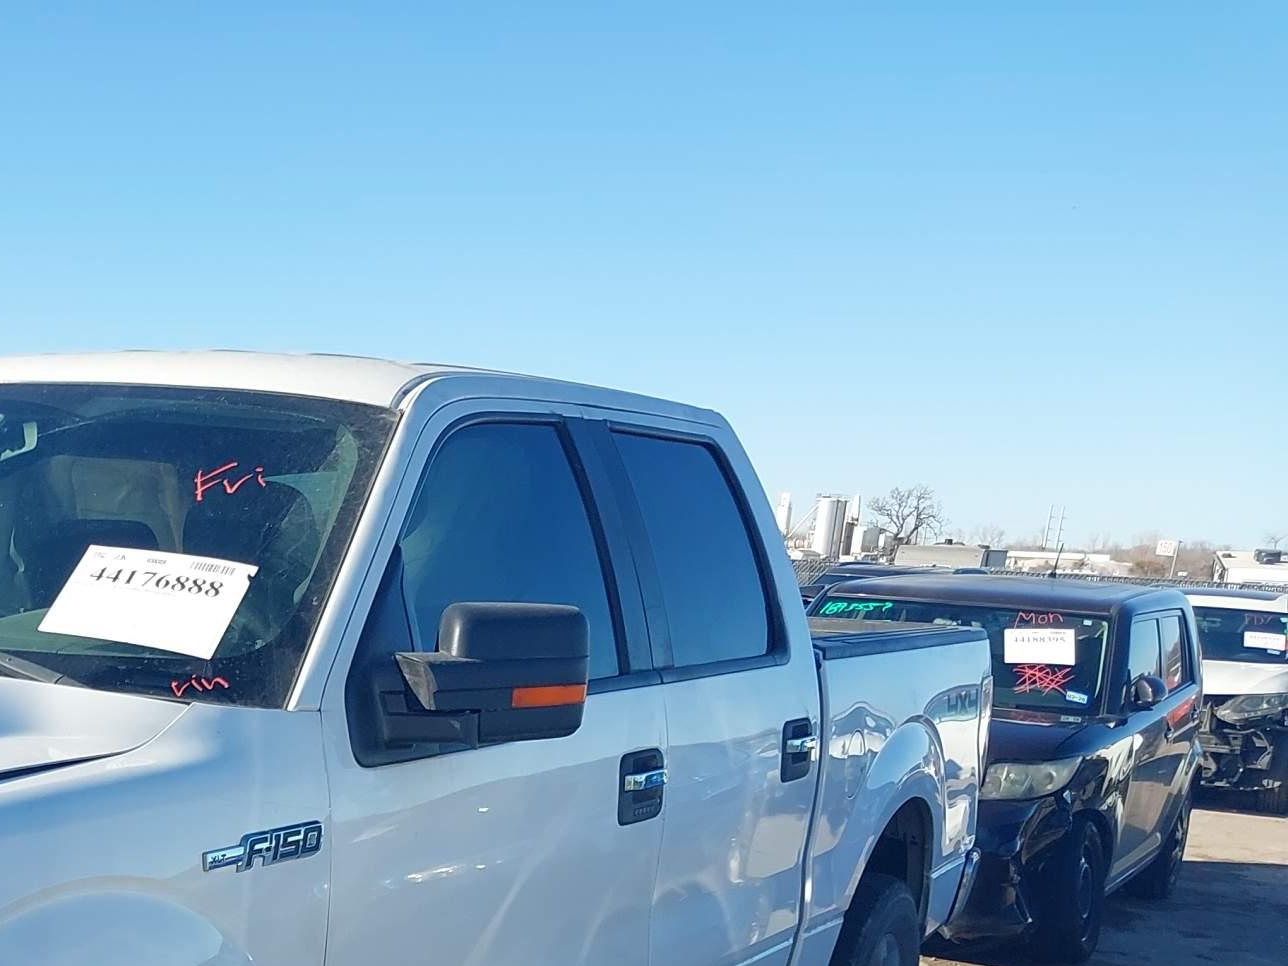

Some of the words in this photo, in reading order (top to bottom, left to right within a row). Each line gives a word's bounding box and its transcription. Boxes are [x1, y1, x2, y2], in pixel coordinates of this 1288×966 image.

[194, 461, 267, 501] Fri
[89, 566, 224, 598] 44176888
[1014, 612, 1064, 629] Mon
[211, 853, 227, 864] XLT
[240, 821, 324, 871] F-150
